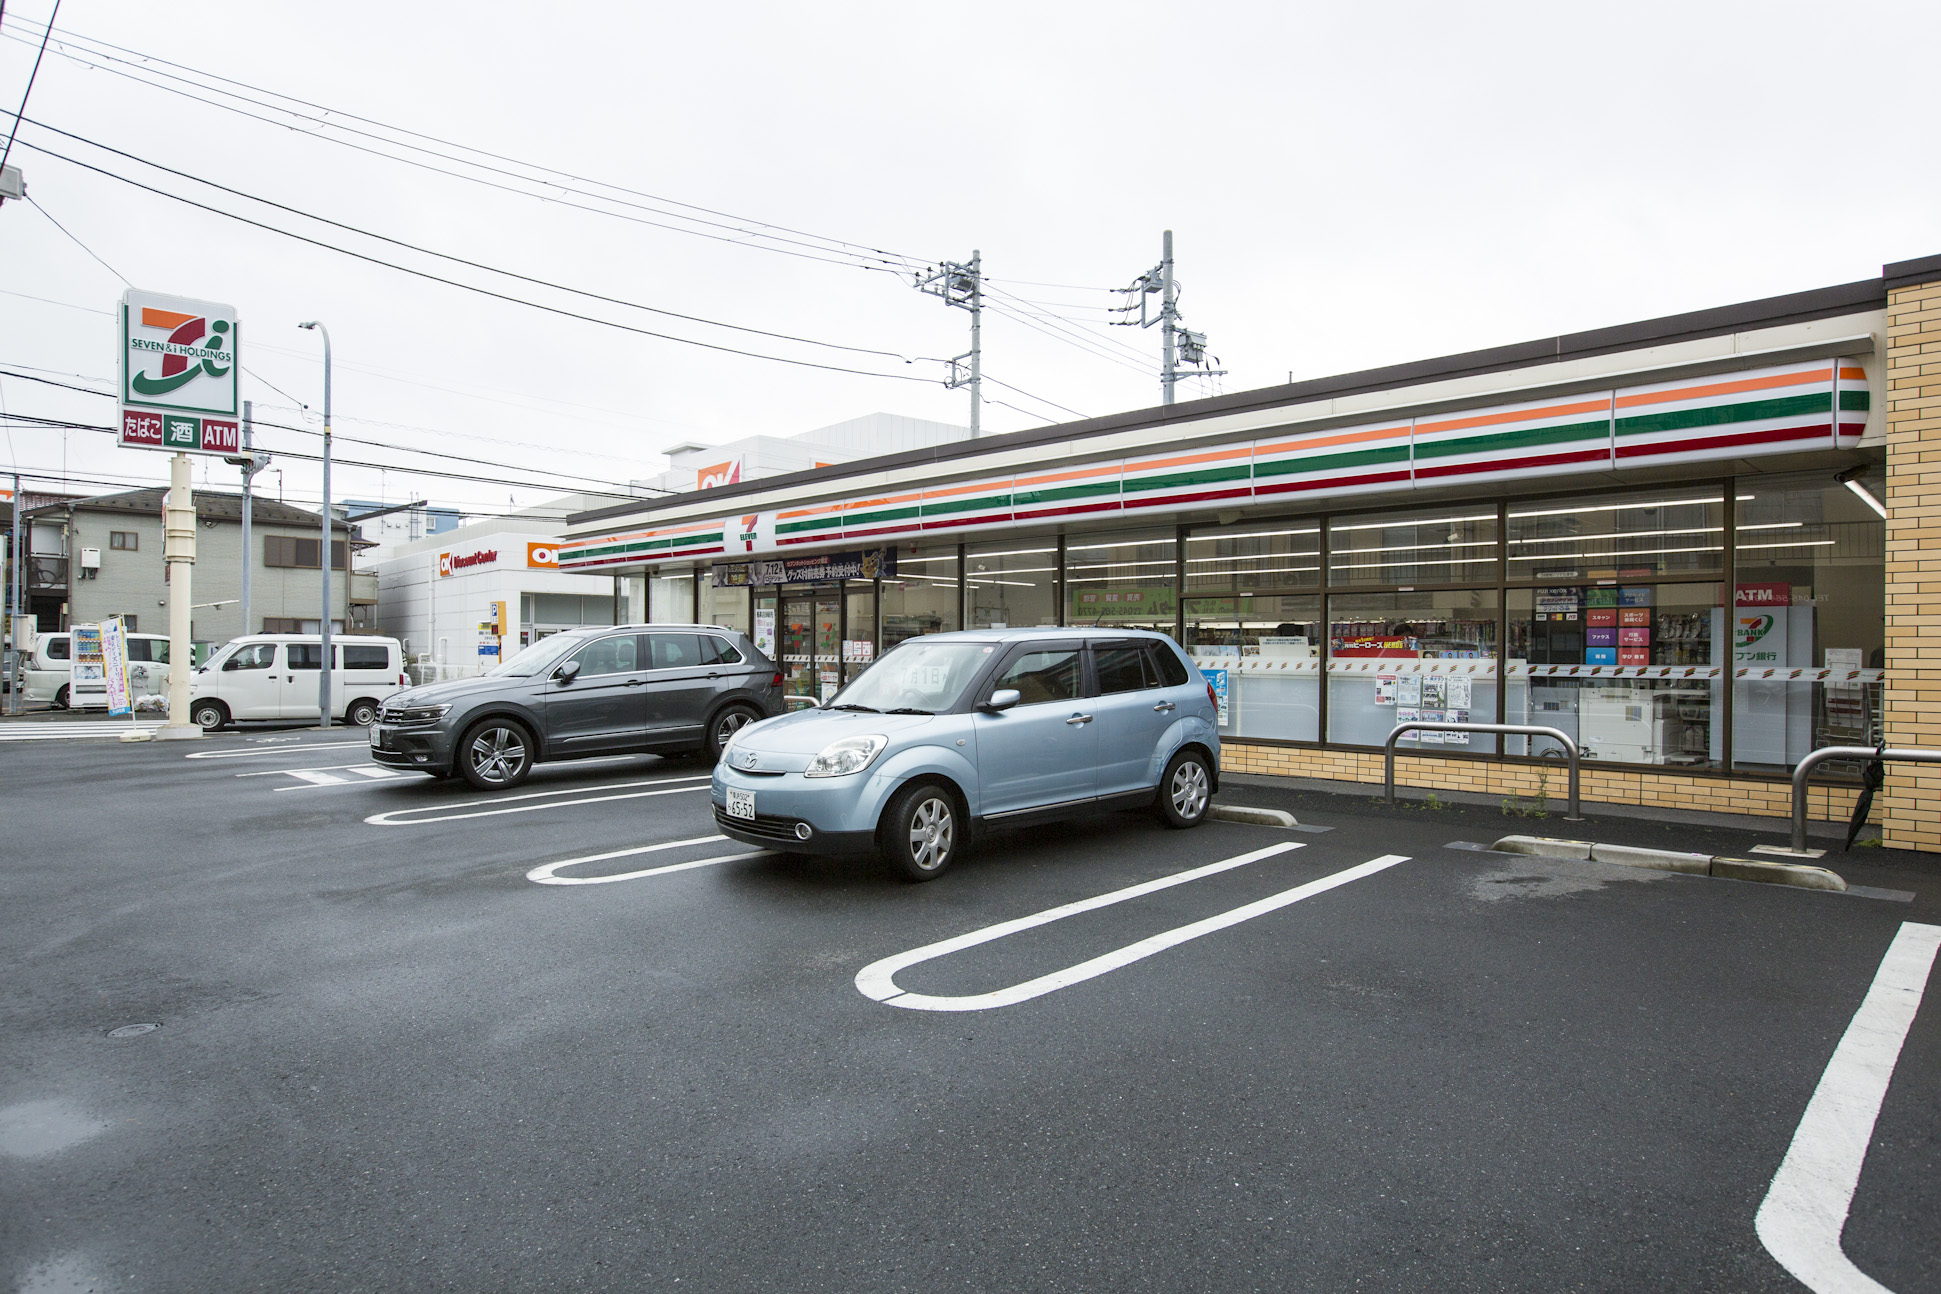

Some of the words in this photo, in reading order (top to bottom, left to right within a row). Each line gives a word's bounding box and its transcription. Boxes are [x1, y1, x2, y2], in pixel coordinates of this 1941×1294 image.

[179, 346, 231, 362] HOLDINGS
[125, 416, 161, 439] たばこ
[171, 421, 194, 442] 酒
[204, 425, 236, 447] ATM
[477, 549, 497, 565] Center
[1736, 589, 1773, 600] ATM
[1737, 629, 1764, 637] BANK
